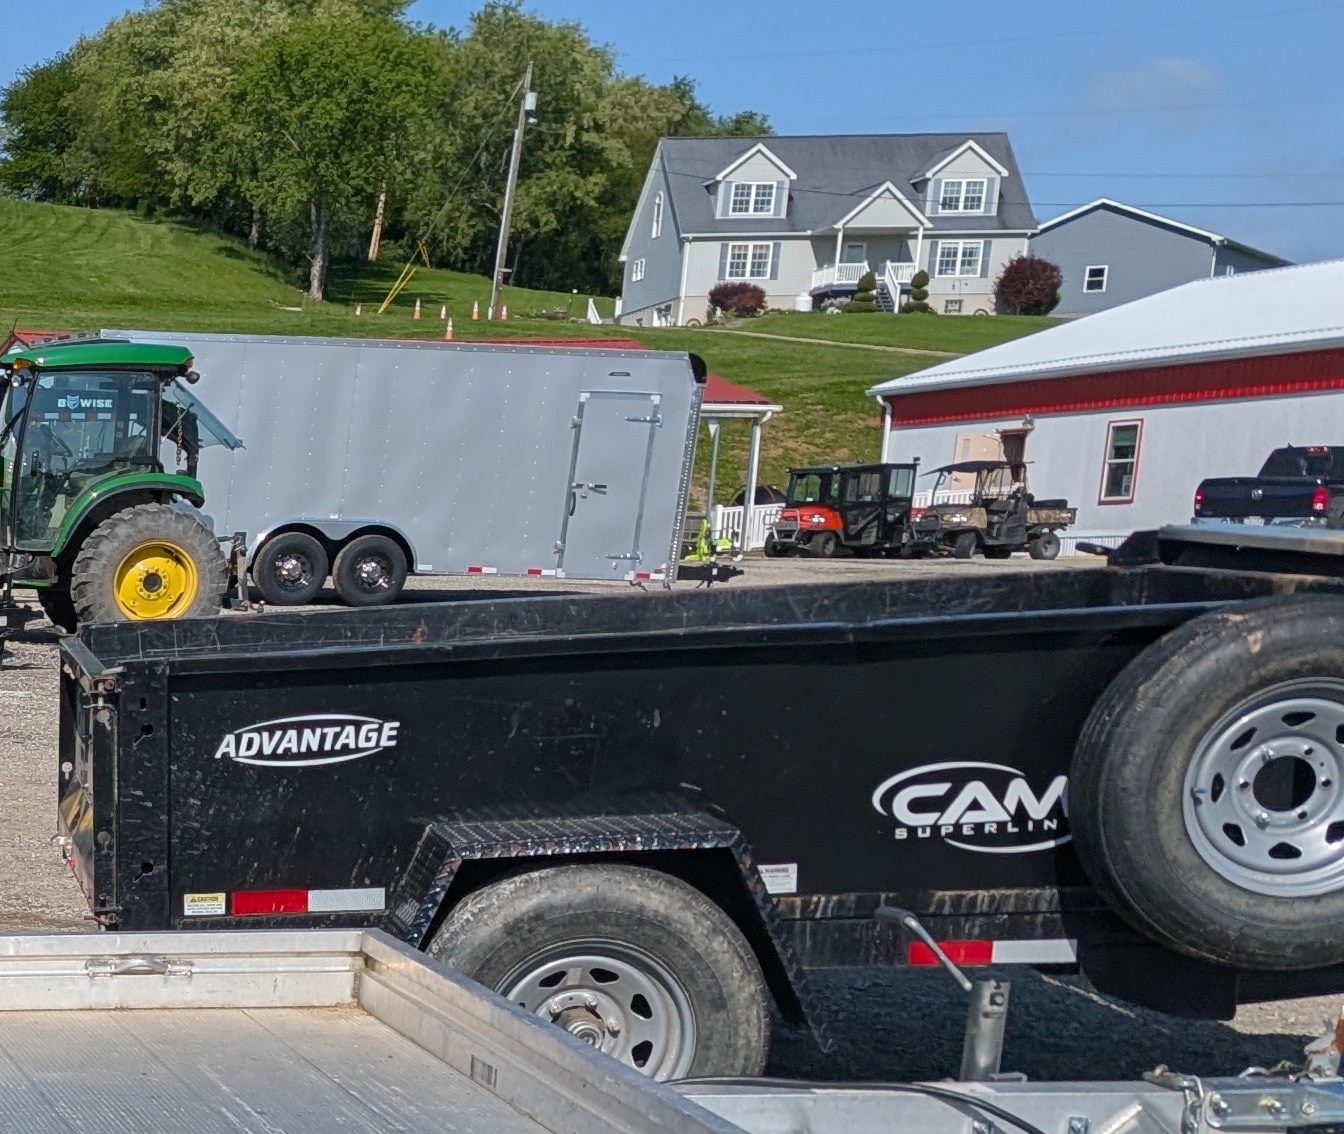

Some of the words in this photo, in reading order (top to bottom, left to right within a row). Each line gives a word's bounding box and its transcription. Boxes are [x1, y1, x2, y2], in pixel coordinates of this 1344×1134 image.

[214, 721, 401, 760] ADVANTAGE
[892, 774, 1069, 827] CAM
[894, 818, 1059, 840] SUPERLIN
